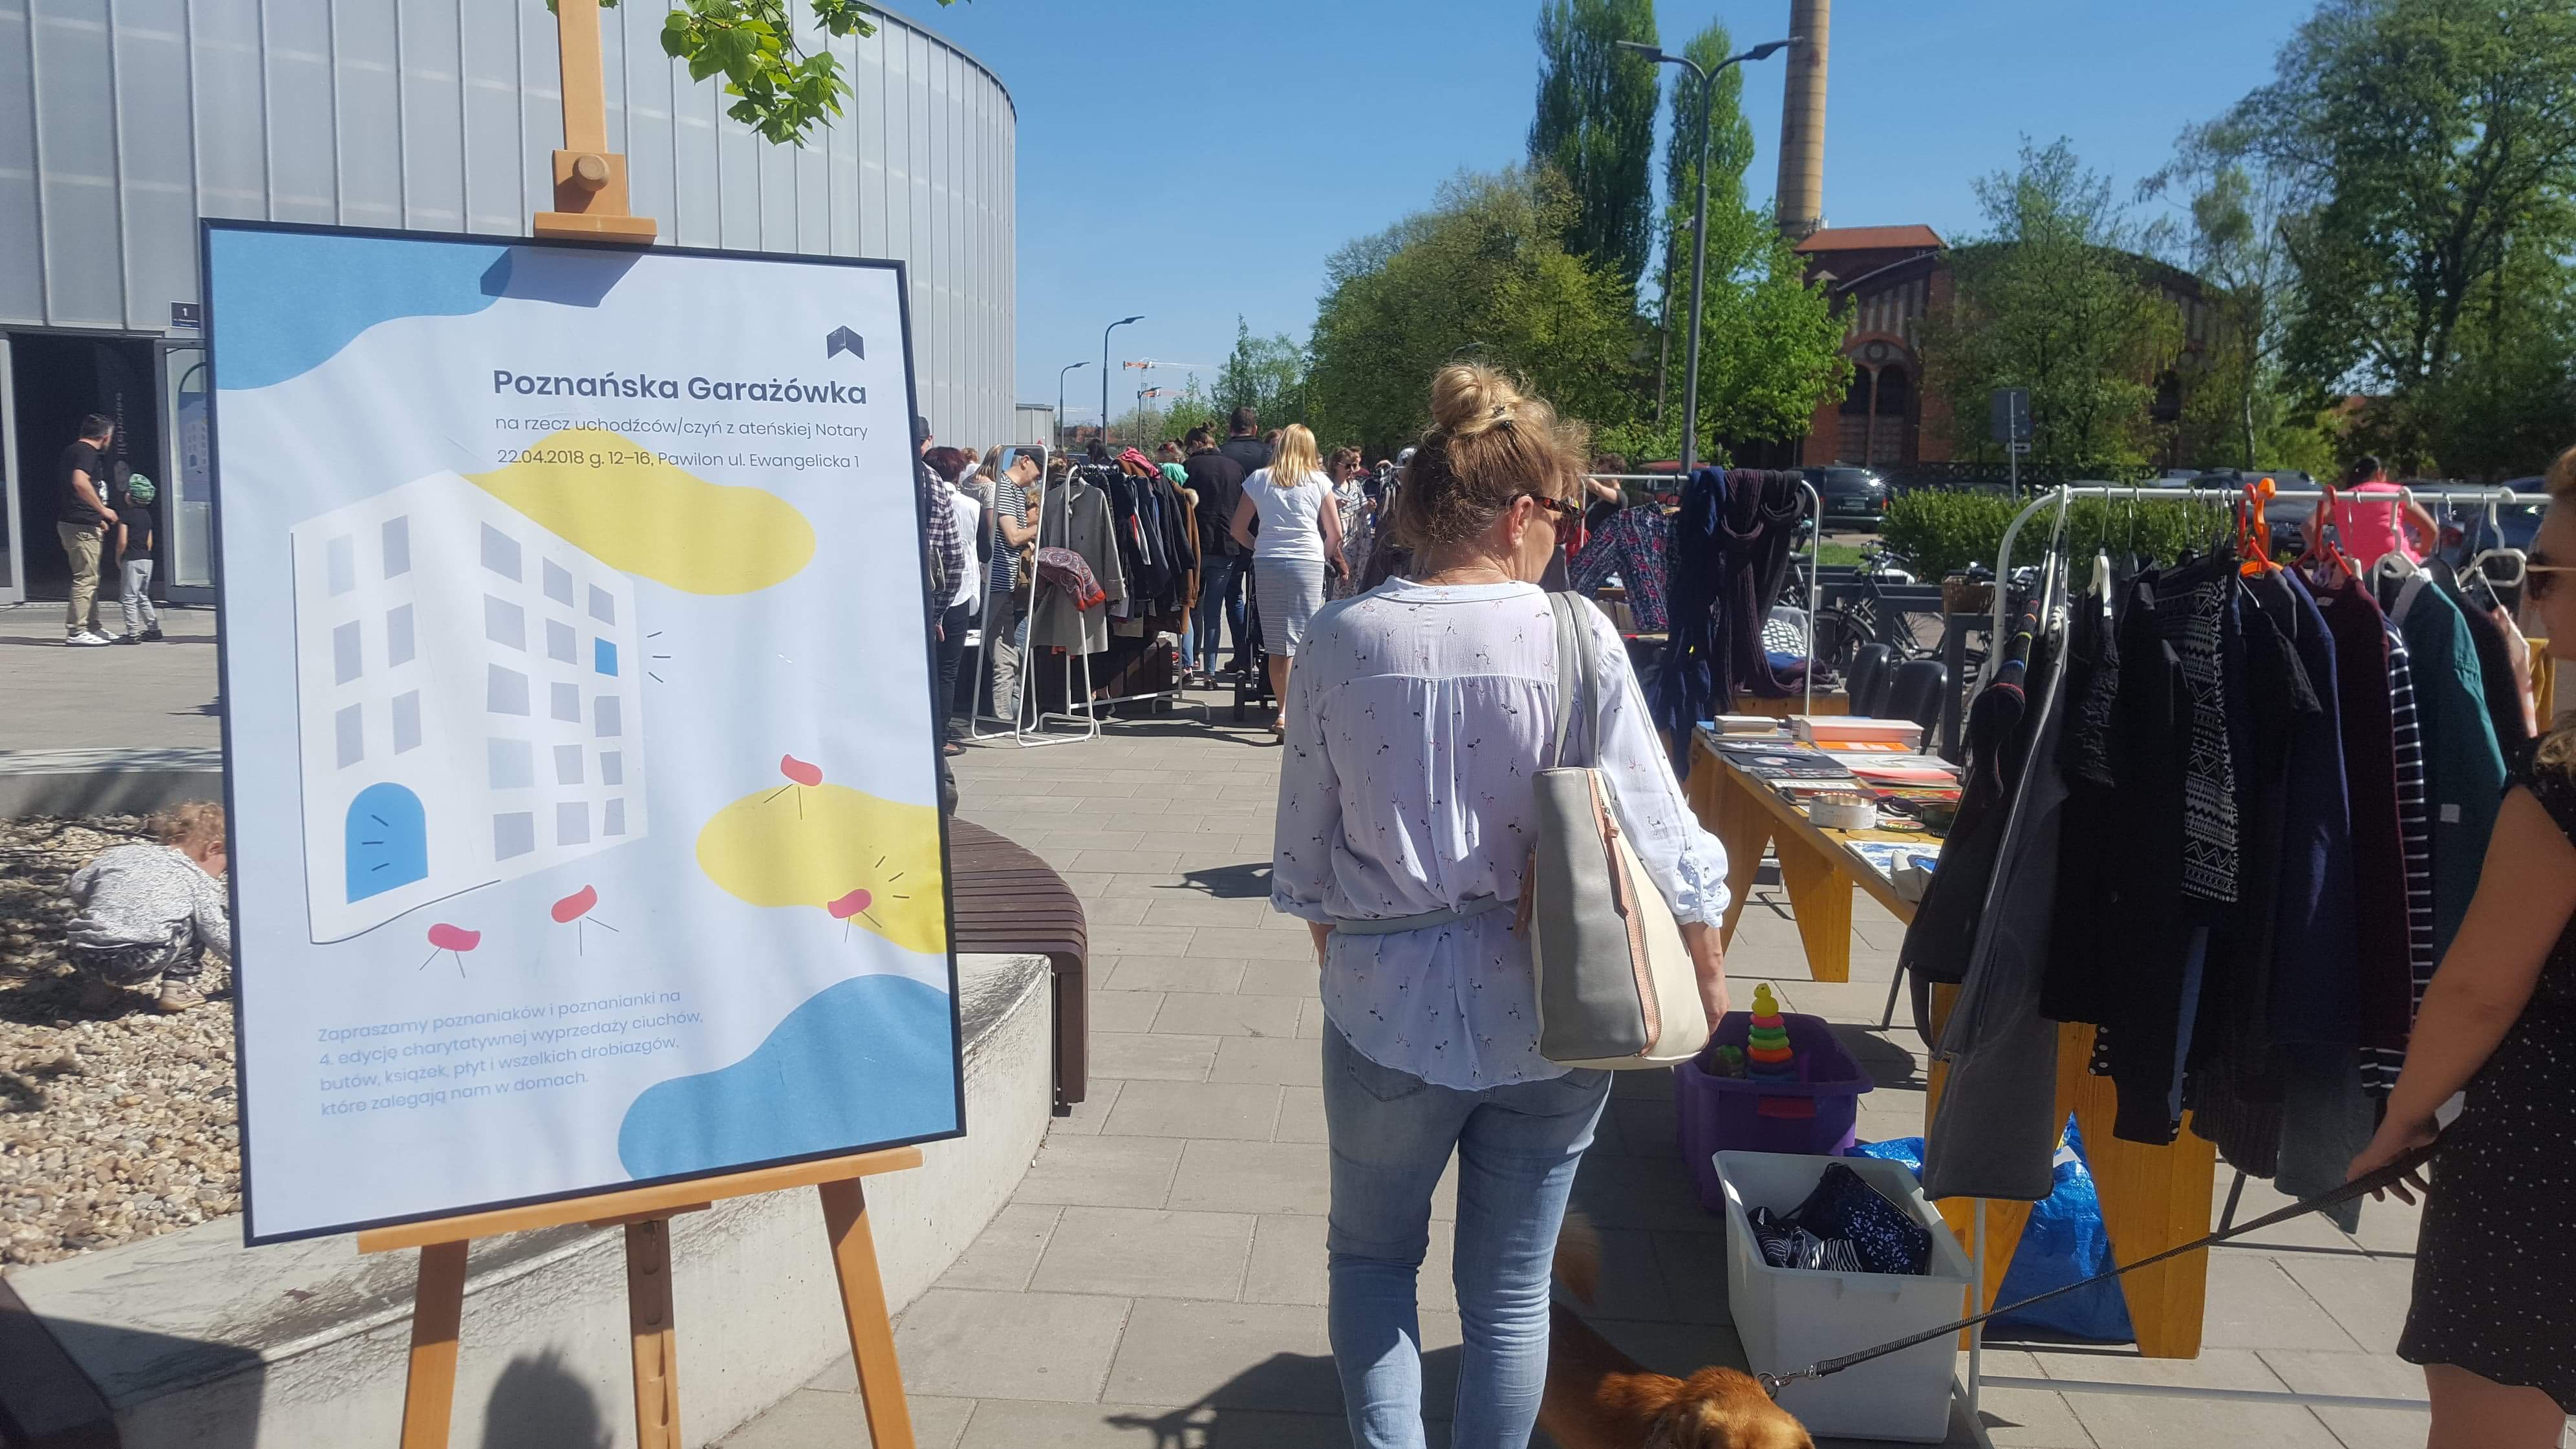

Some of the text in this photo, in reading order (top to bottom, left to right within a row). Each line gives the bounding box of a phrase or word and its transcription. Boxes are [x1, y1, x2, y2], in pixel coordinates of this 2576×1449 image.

[493, 370, 867, 404] Poznańska Garażówka
[495, 416, 868, 441] na rzecz uchodźców/czyń z ateńskiej Notary
[497, 449, 585, 464] 22.04.2018
[590, 453, 605, 469] g.
[658, 452, 723, 466] Pawilon
[728, 453, 746, 466] ul.
[749, 453, 851, 471] Ewangelicka
[854, 455, 859, 467] 1
[317, 991, 680, 1044] Zapraszamy poznaniaków i poznanianki na
[319, 1011, 703, 1066] 4. edycję charytatywnej wyprzedaży ciuchów,
[319, 1073, 381, 1092] butów,
[453, 1060, 486, 1079] płyt
[489, 1058, 494, 1071] i
[497, 1048, 577, 1069] wszelkich
[581, 1036, 680, 1060] drobiazgów,
[321, 1071, 589, 1116] które zalegają nam w domach.
